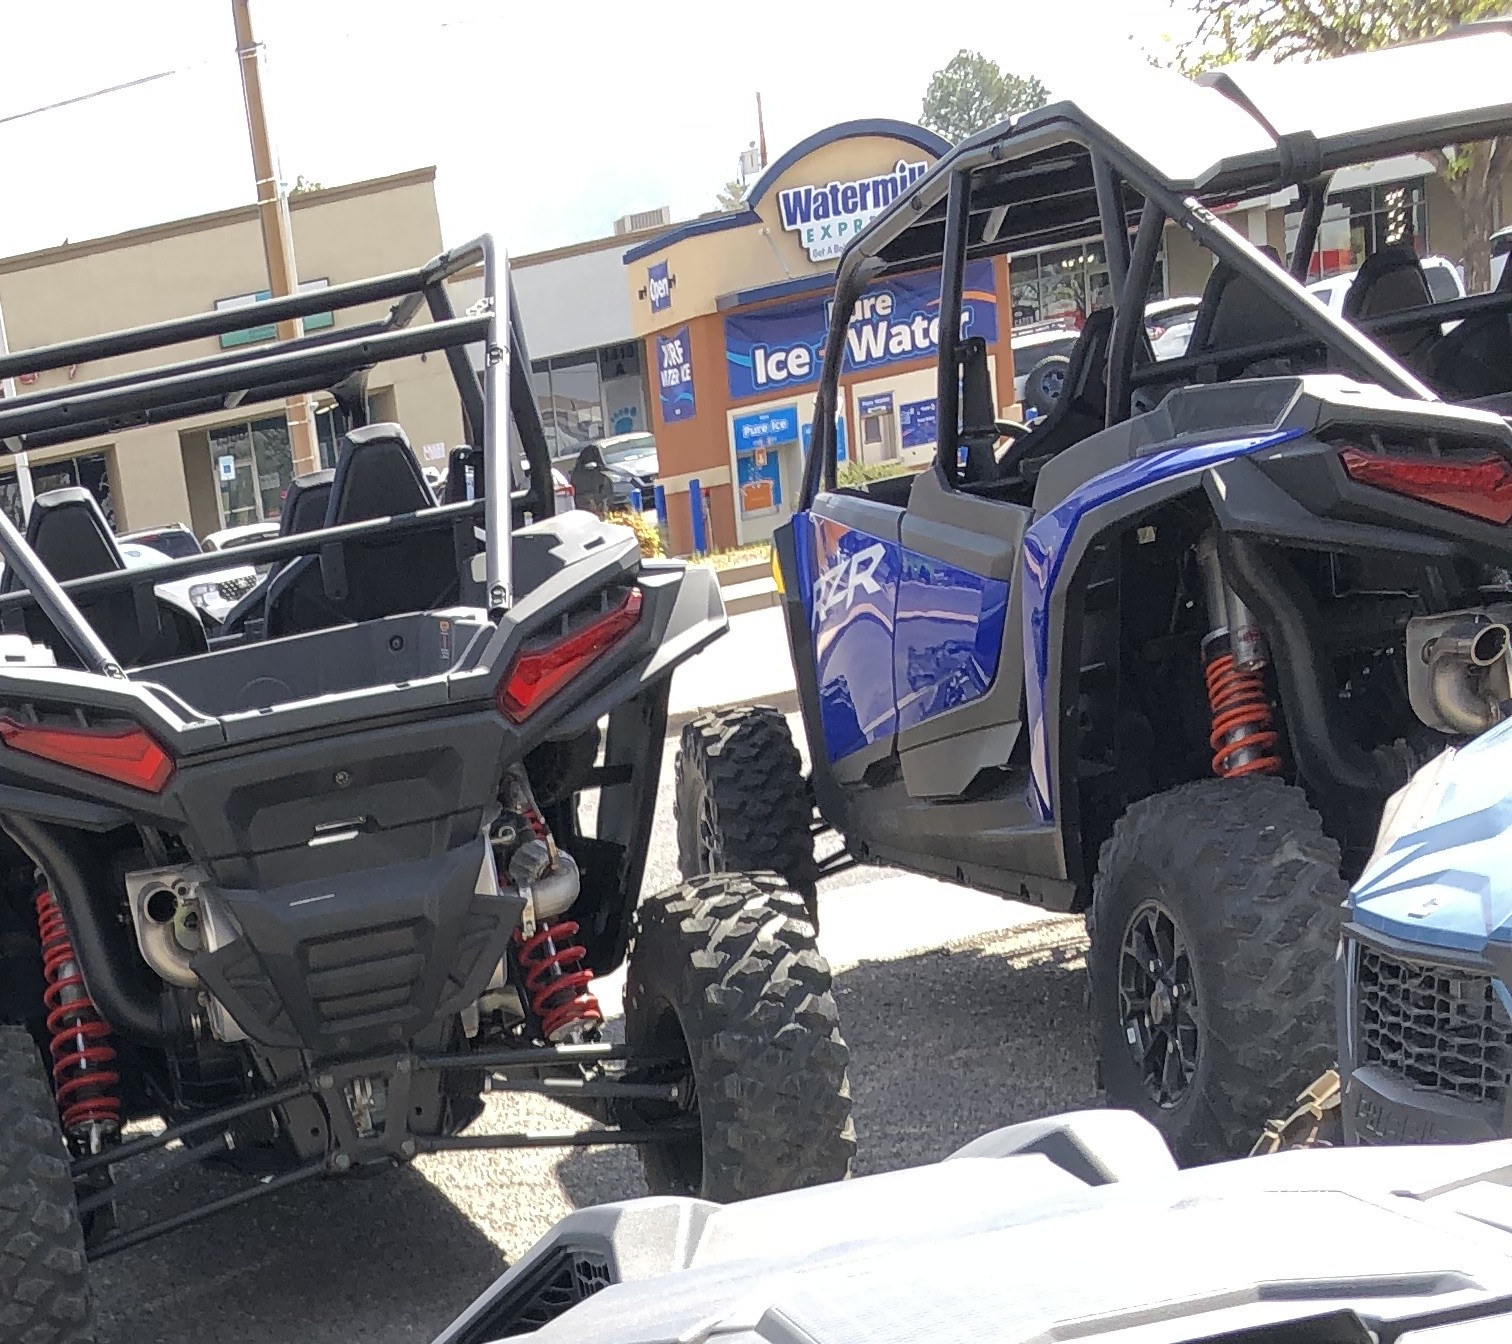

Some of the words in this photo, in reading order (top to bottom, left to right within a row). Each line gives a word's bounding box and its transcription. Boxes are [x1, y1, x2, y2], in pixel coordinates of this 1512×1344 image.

[650, 277, 670, 307] Open
[755, 346, 811, 384] Ice
[743, 423, 768, 439] Pure
[771, 419, 788, 432] Ice
[811, 543, 886, 632] RZR
